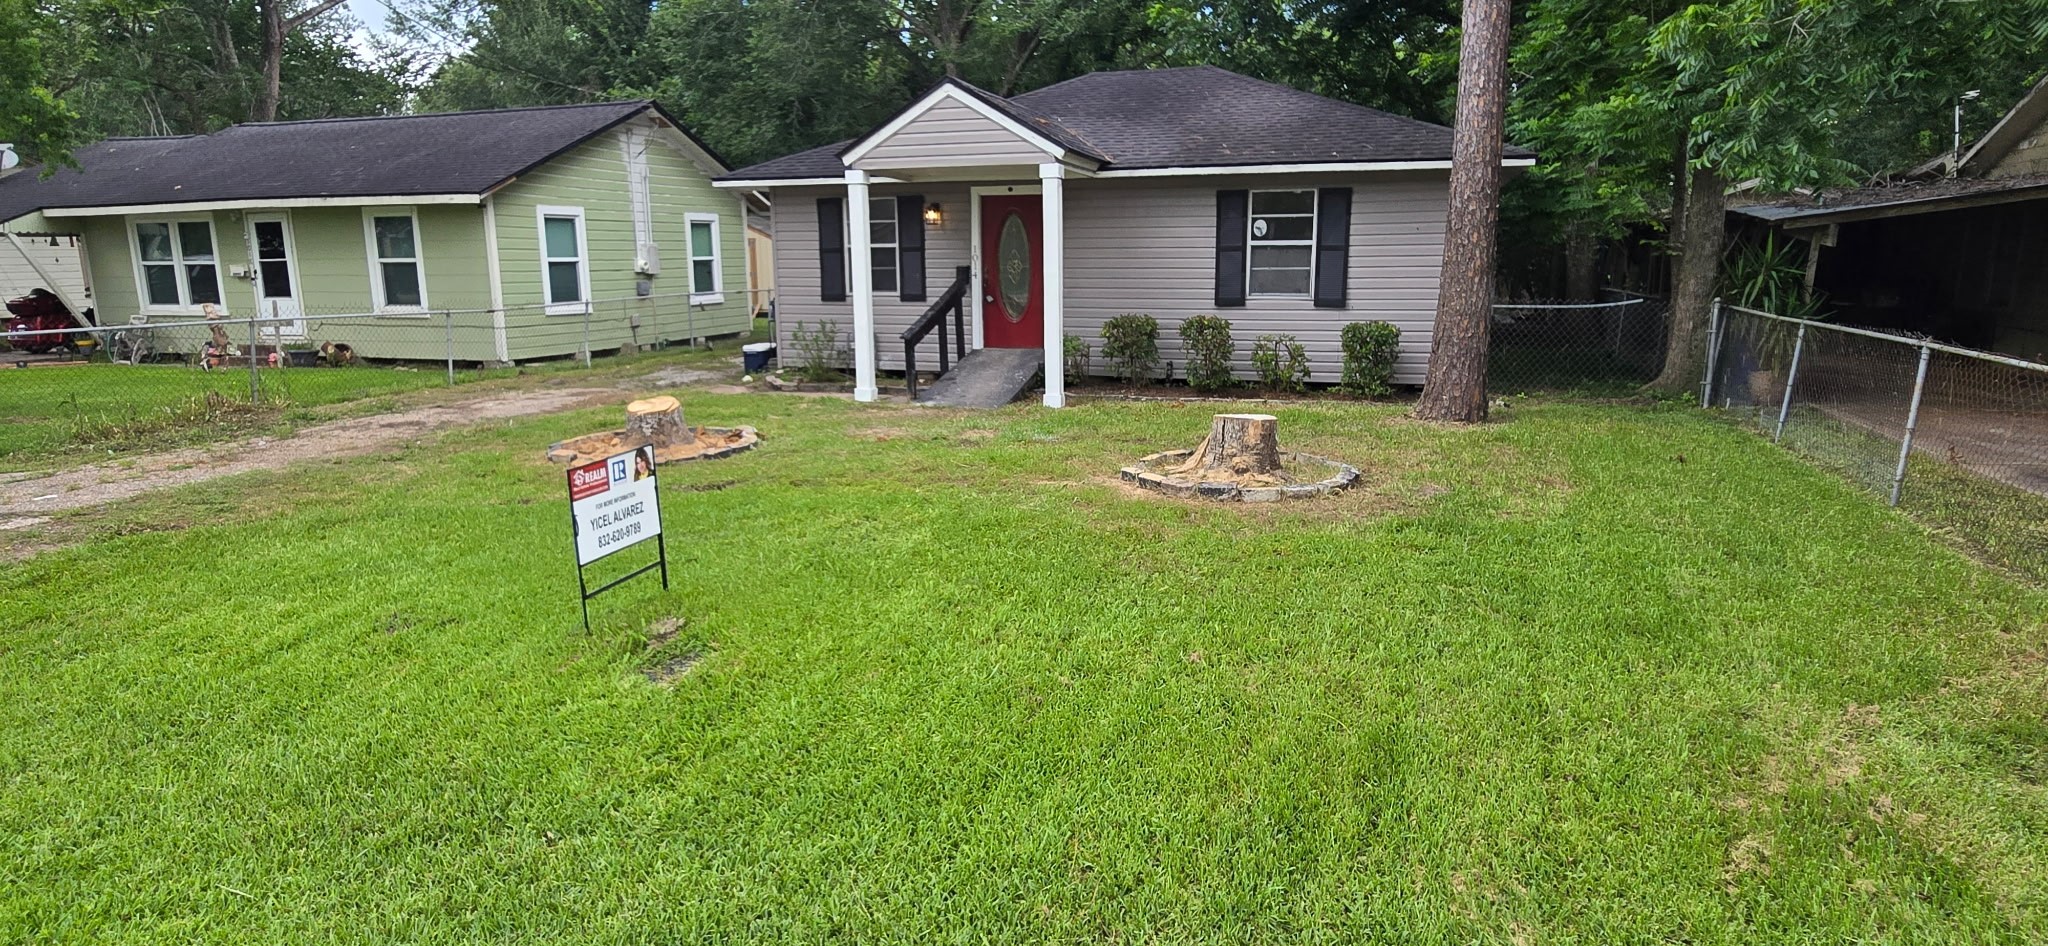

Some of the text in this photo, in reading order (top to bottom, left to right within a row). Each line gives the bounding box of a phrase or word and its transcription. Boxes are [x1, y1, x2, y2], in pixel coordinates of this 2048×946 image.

[585, 467, 607, 483] REALM
[590, 501, 645, 531] YICEL ALVAREZ
